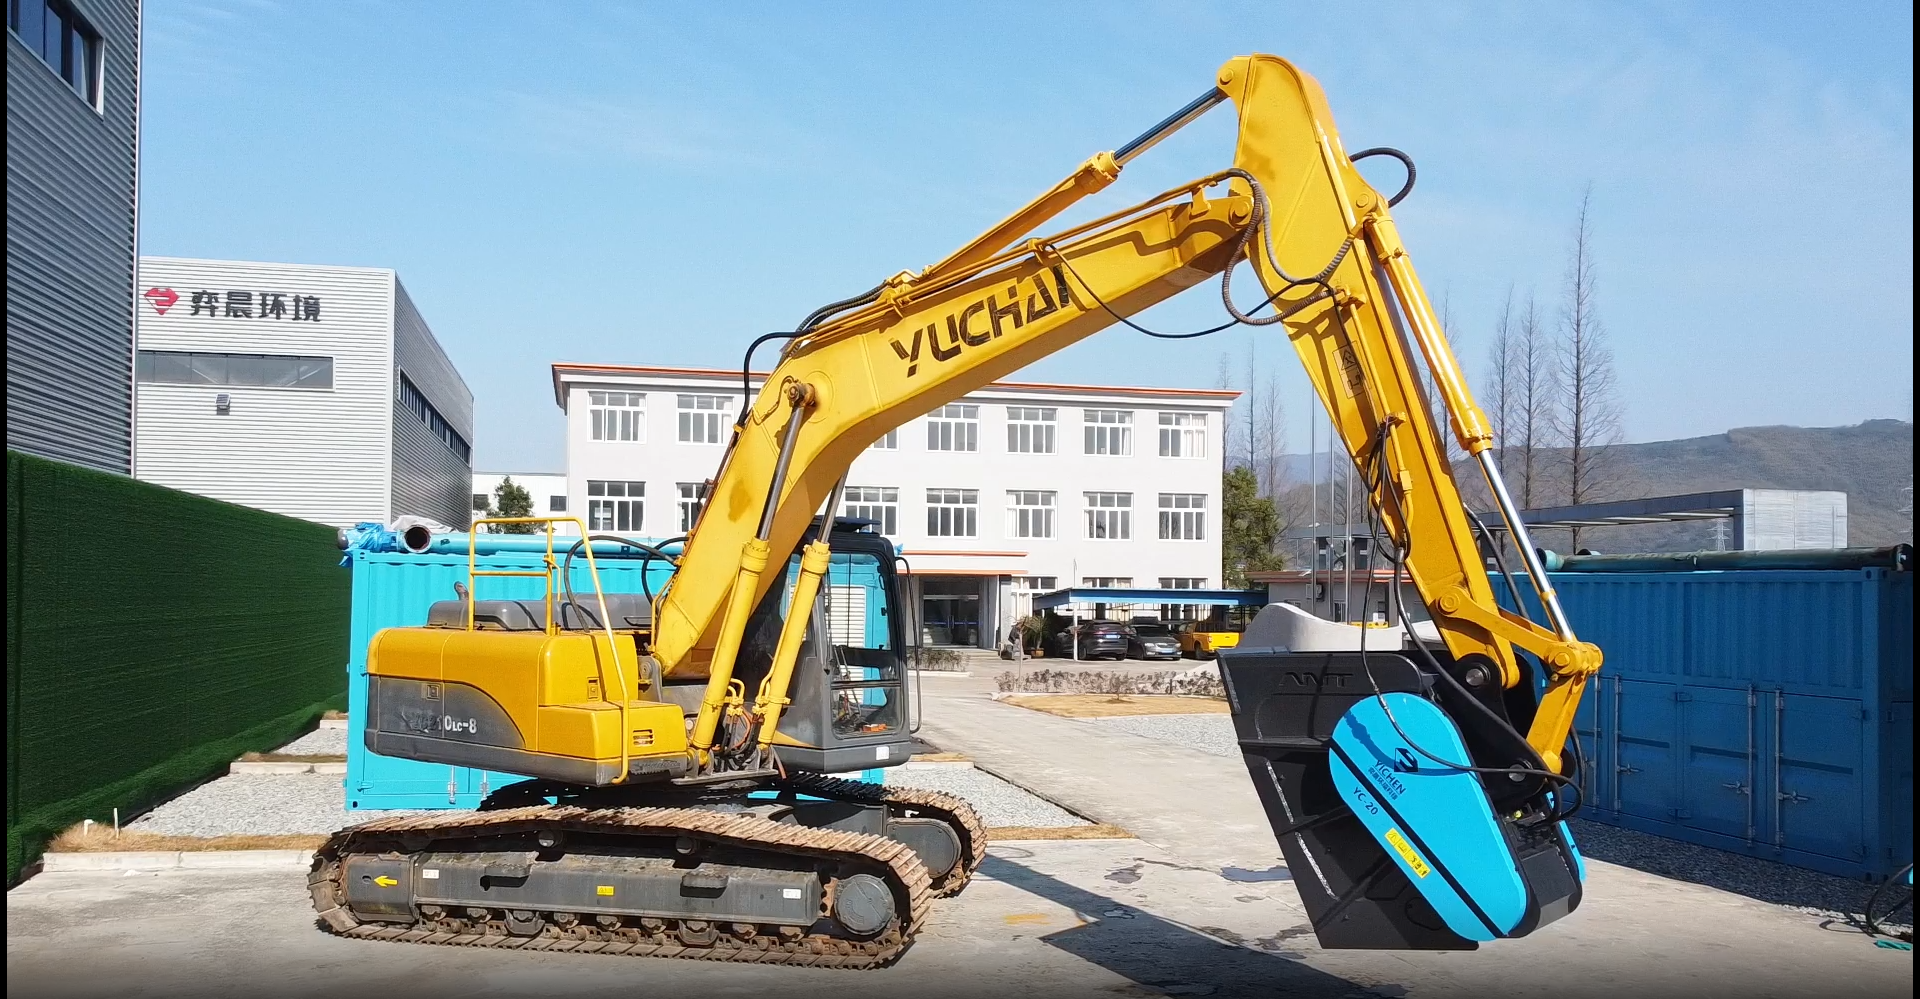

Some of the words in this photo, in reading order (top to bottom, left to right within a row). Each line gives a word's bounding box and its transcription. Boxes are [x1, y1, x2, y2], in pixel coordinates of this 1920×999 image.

[888, 262, 1070, 378] YUCHAI
[1375, 759, 1407, 796] YICHEN
[1353, 786, 1380, 816] YC-20
